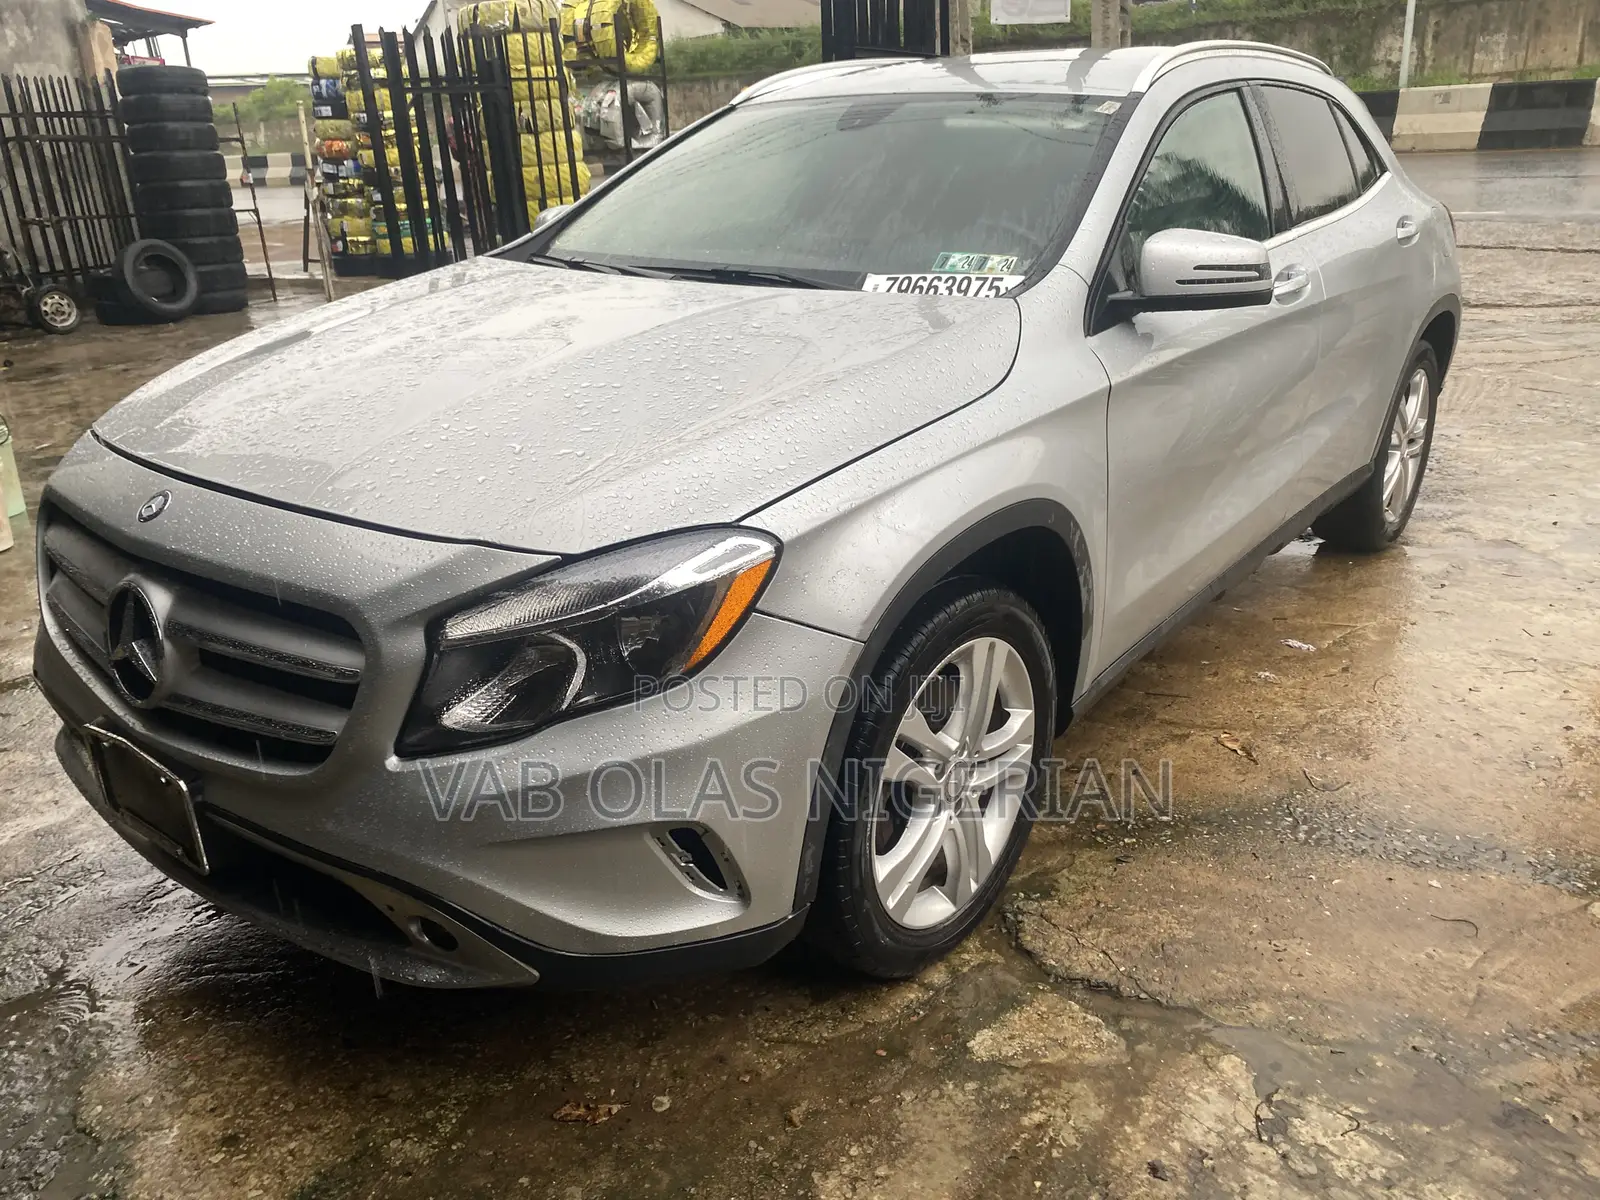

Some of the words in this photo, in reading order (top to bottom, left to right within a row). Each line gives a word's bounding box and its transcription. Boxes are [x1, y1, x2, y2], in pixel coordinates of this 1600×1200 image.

[939, 256, 949, 269] 7
[961, 255, 975, 269] 24
[978, 256, 988, 270] 7
[1000, 258, 1014, 272] 24
[885, 275, 1004, 298] 79663975
